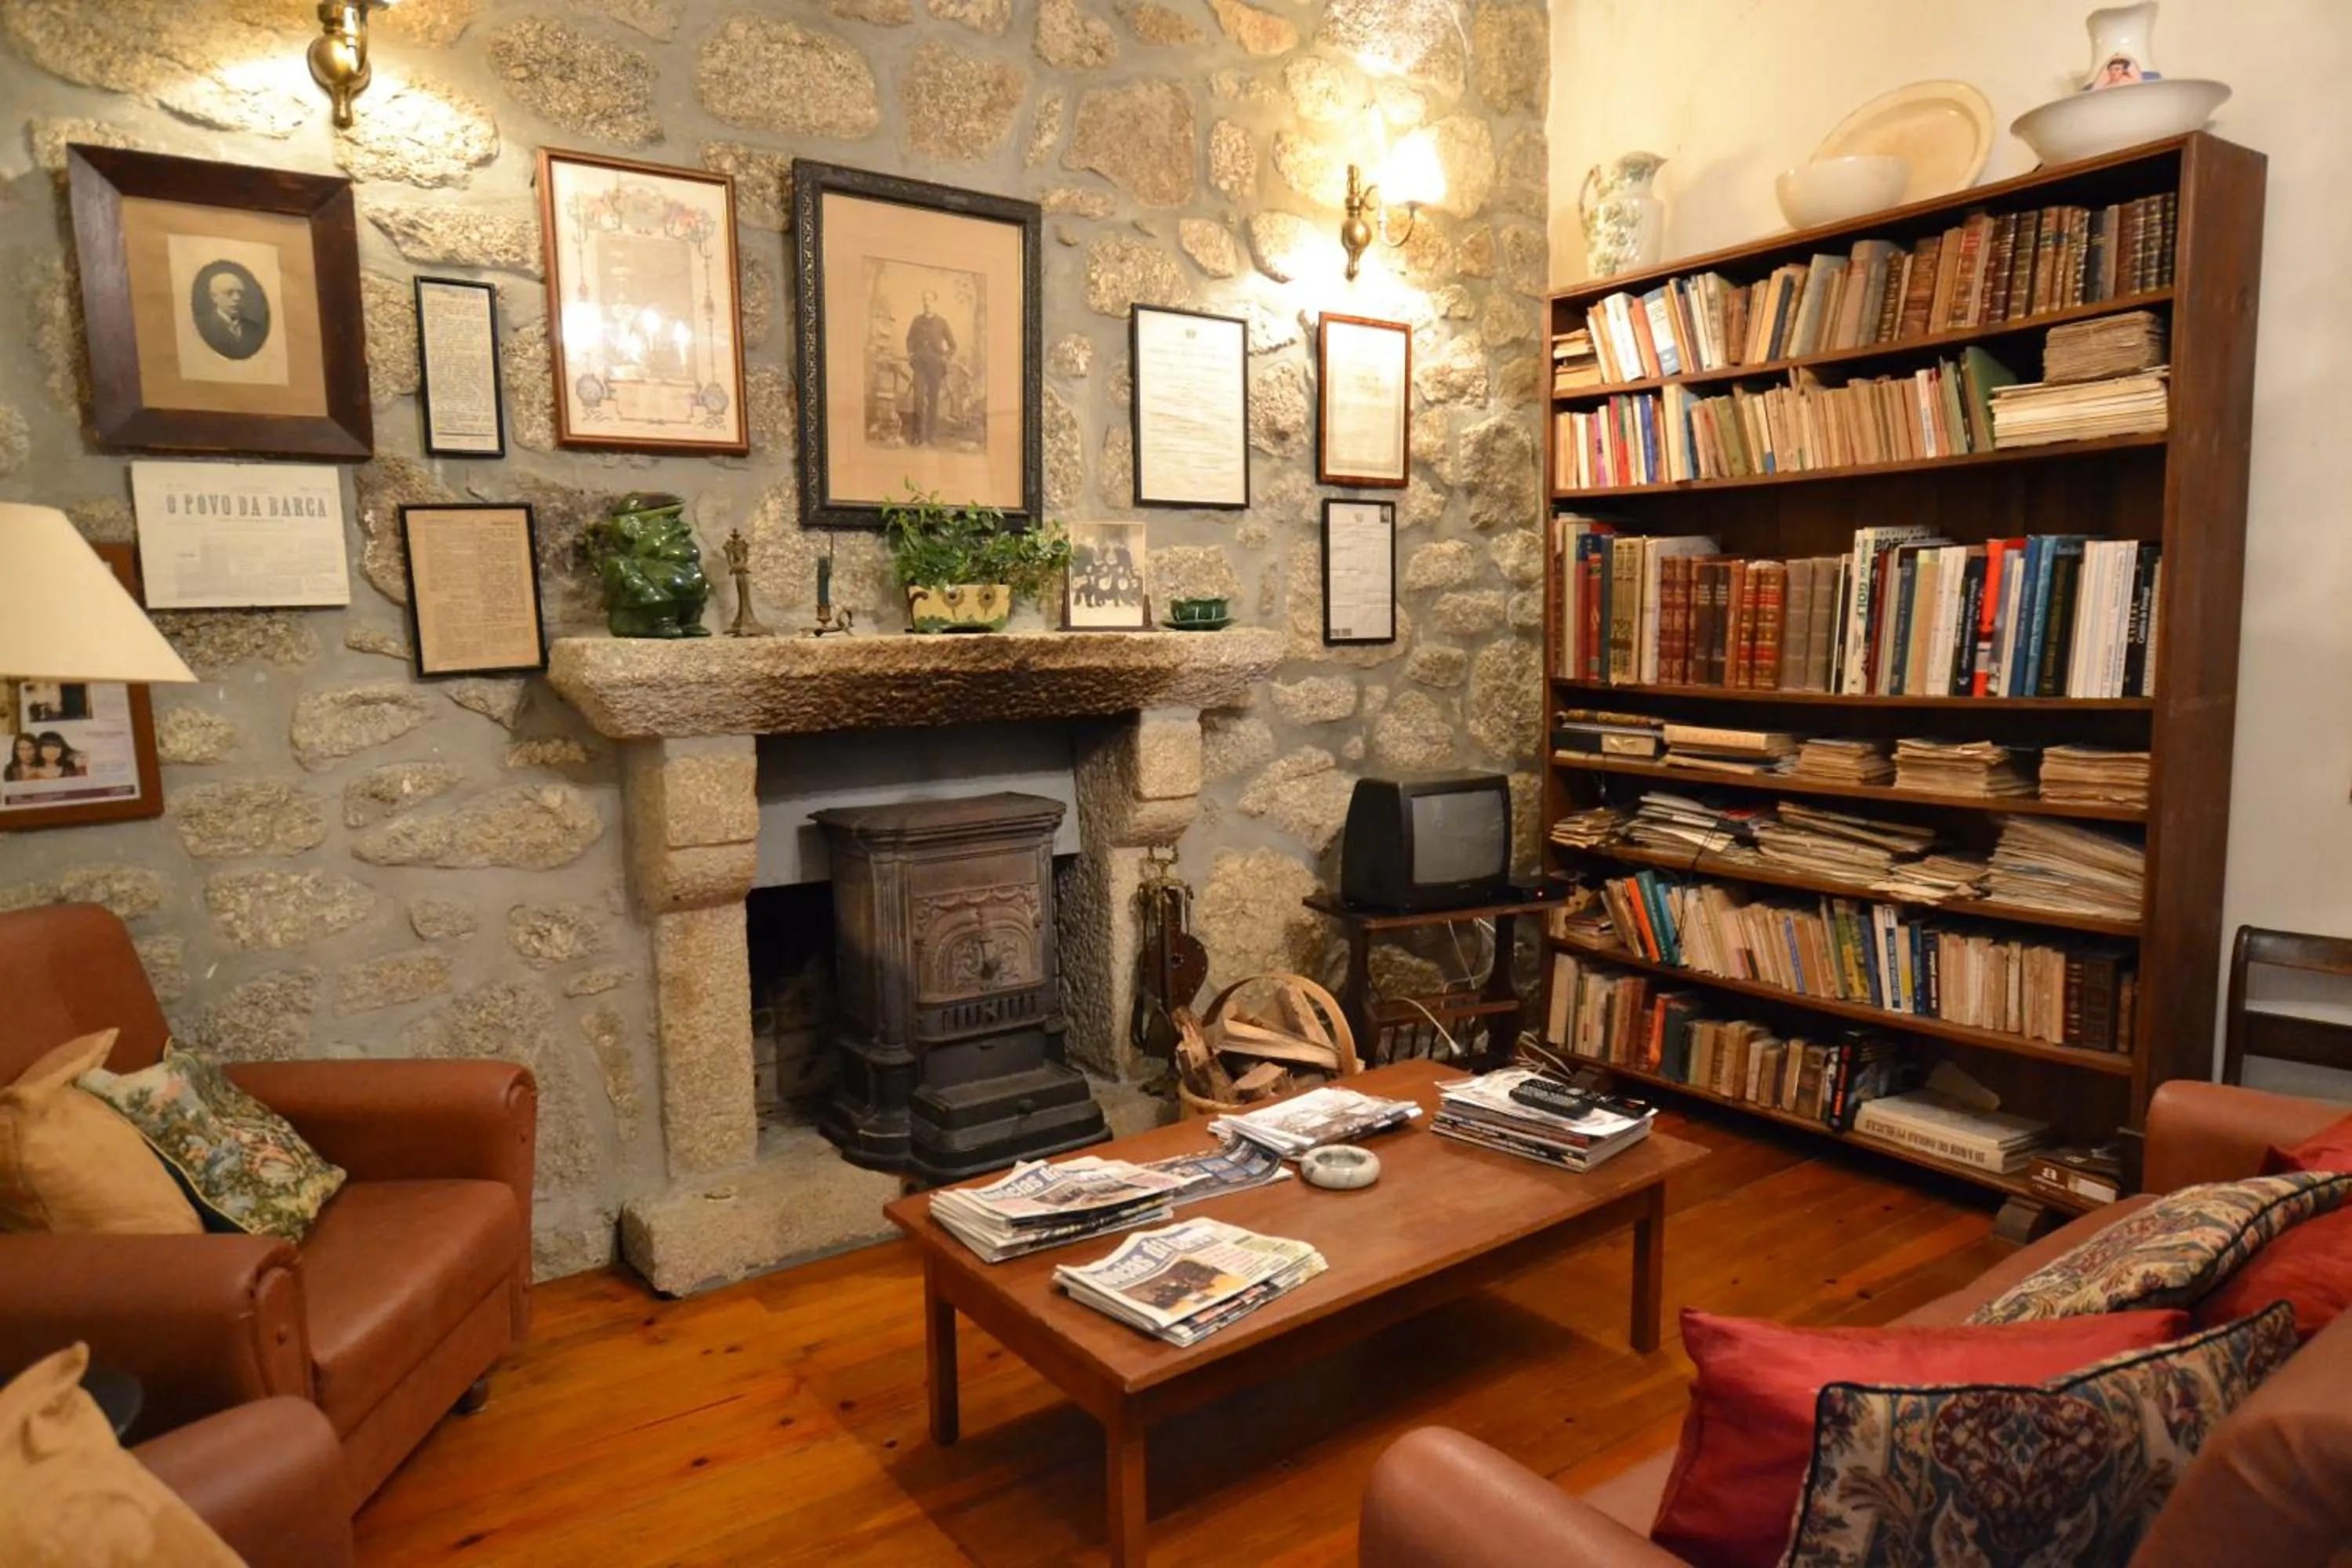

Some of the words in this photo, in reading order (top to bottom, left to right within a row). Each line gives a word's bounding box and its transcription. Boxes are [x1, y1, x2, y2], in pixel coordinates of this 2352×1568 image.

[165, 493, 177, 515] O
[183, 493, 233, 516] POVO
[237, 495, 263, 517] DA
[267, 495, 328, 518] BARCA
